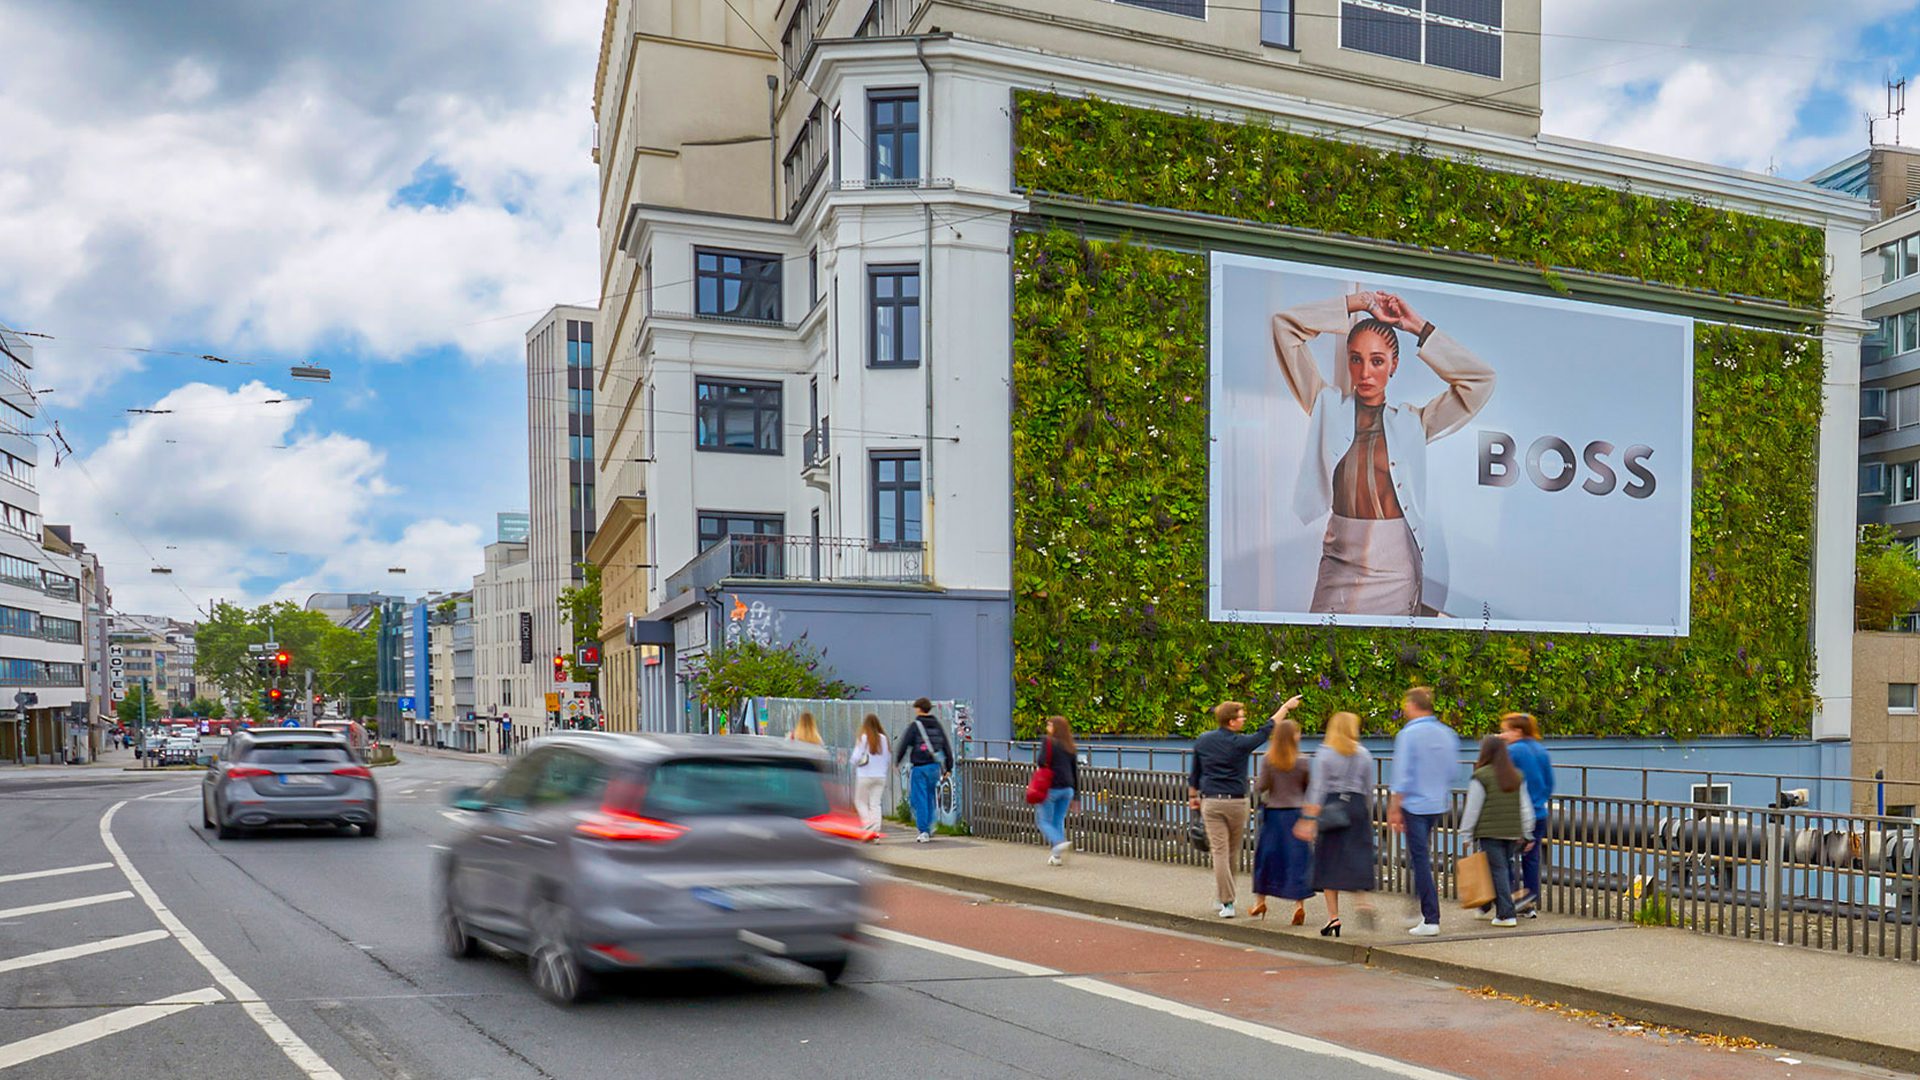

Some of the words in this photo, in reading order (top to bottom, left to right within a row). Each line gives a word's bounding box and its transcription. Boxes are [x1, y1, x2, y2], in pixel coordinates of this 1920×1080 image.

[1478, 430, 1657, 499] BOSS
[522, 614, 530, 639] HOTEL
[111, 646, 123, 699] HOTEL
